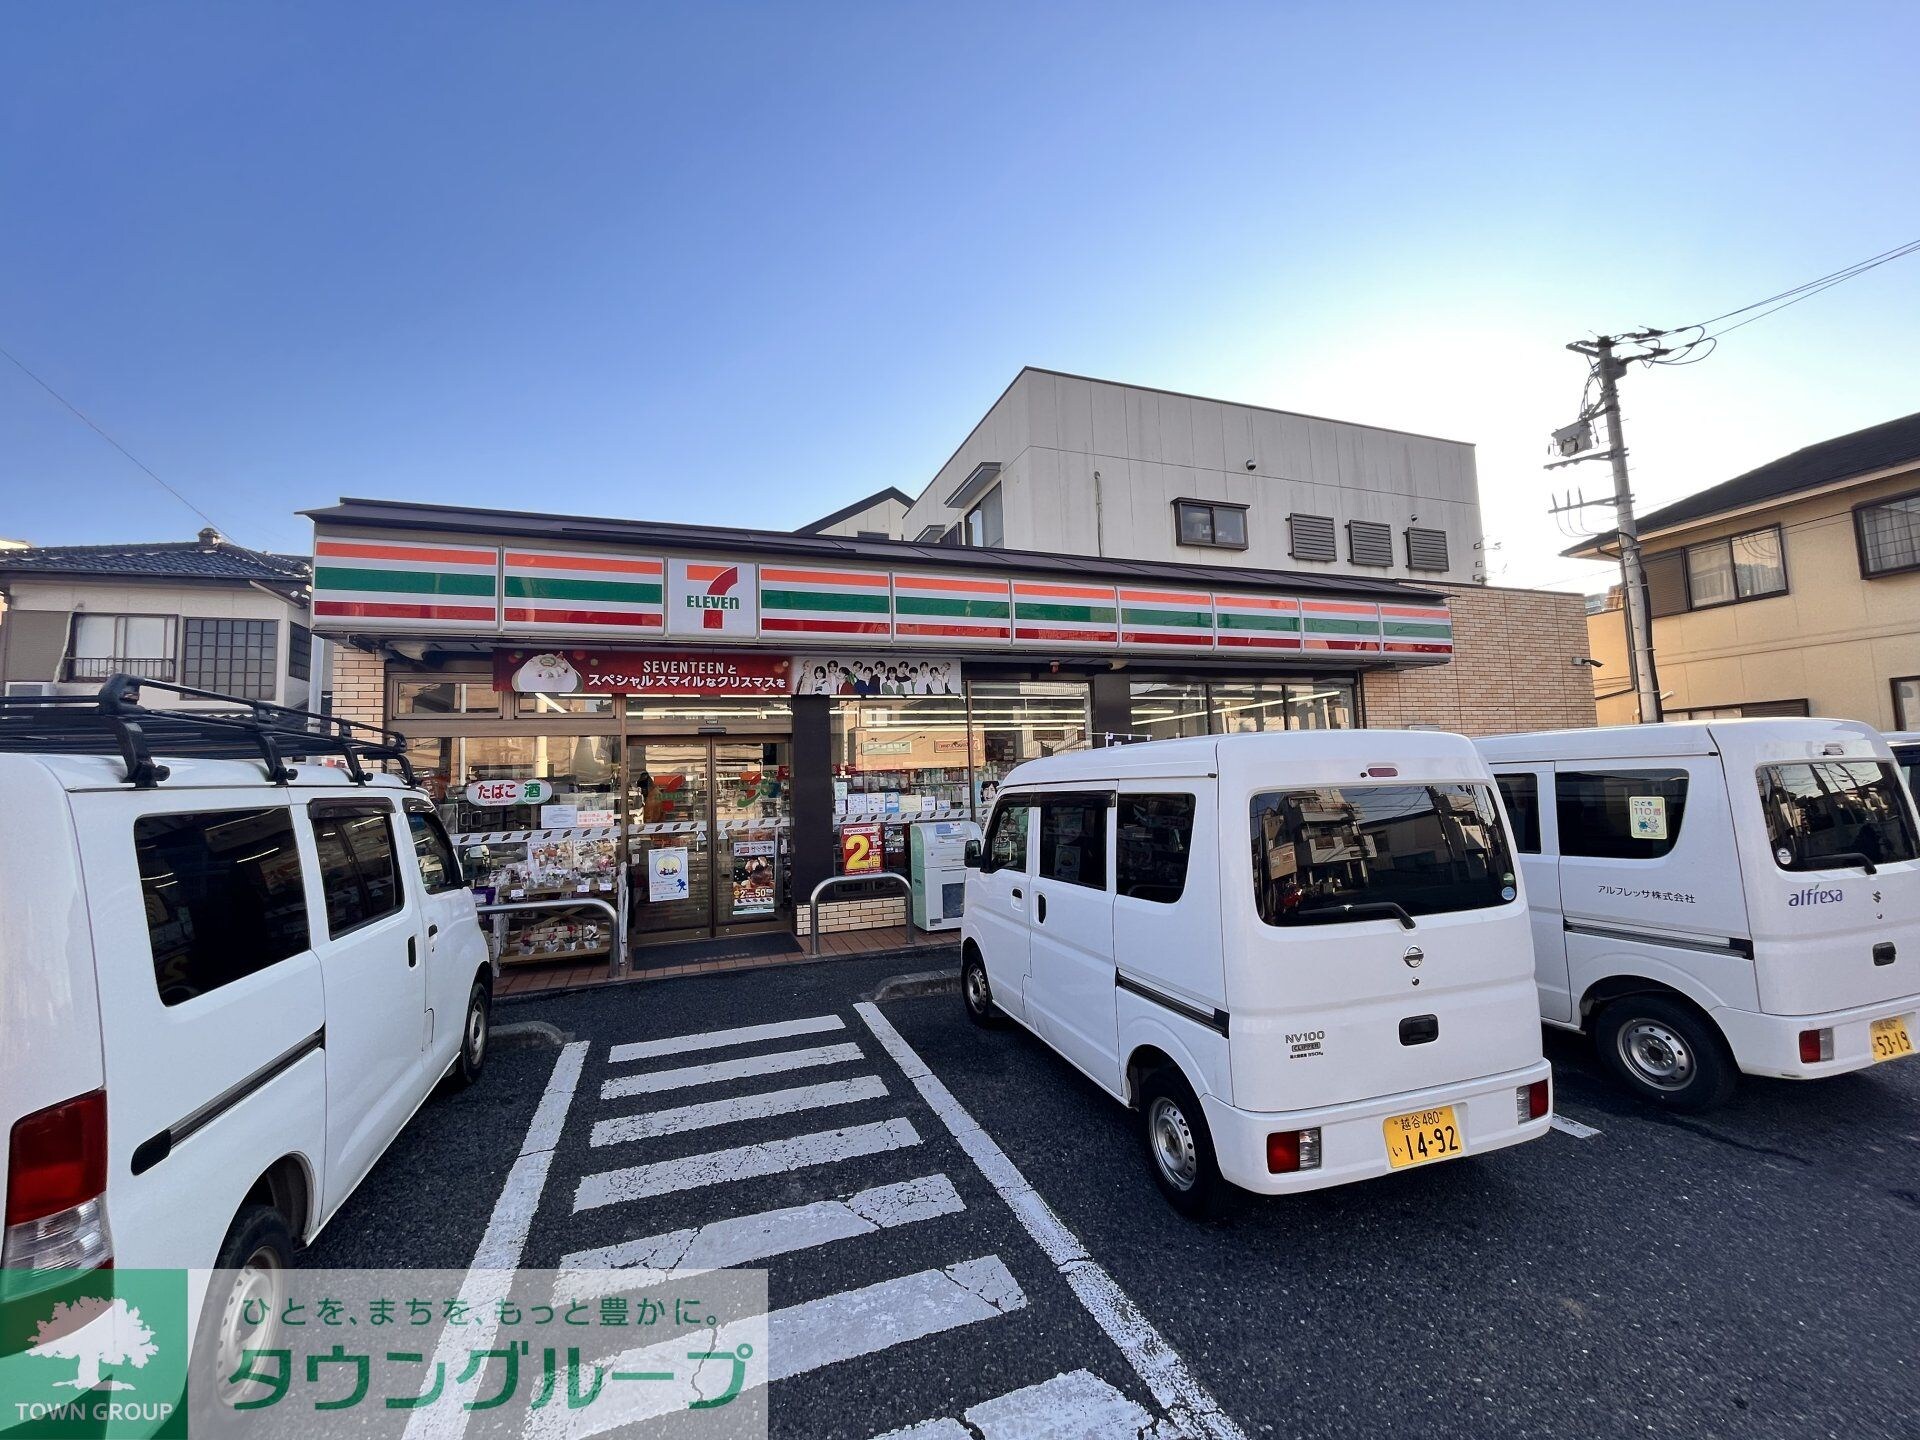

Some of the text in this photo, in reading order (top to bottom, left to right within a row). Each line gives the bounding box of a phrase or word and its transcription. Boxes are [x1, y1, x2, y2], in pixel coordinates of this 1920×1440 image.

[686, 595, 740, 610] ELEVEN
[643, 660, 724, 674] SEVENTEEN
[477, 783, 541, 799] たばこ 酒
[845, 834, 870, 871] 2
[1598, 885, 1696, 904] アルフレッサ株式会社
[1788, 886, 1843, 907] alfresa
[1285, 1030, 1325, 1044] NV100
[1876, 1030, 1911, 1056] 53-19
[1392, 1125, 1459, 1161] い 14-92
